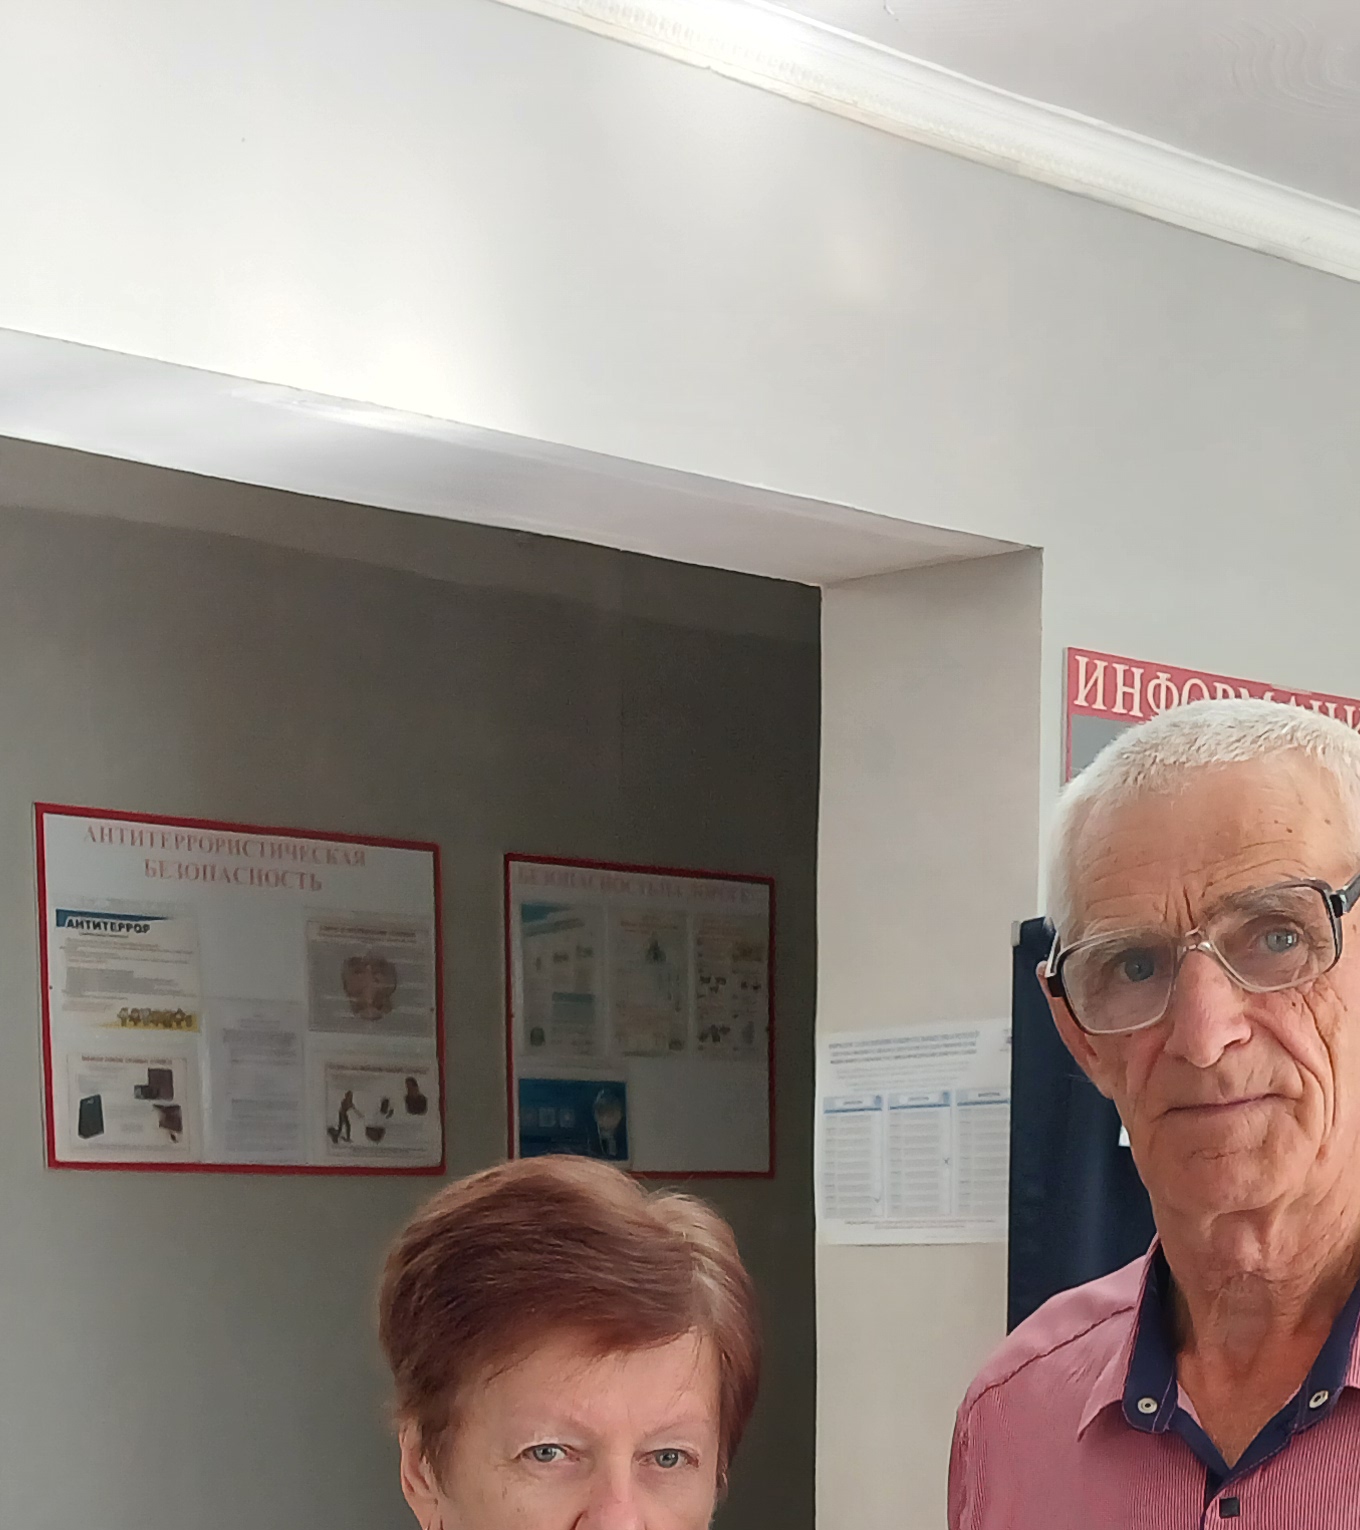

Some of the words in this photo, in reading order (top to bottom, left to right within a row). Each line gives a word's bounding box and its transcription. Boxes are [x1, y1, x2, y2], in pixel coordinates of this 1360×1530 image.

[85, 825, 366, 867] АНТИТЕРРОРИСТИЧЕСКАЯ
[144, 858, 323, 892] БЕЗОПАСНОСТЬ
[67, 918, 151, 934] АНТИТЕРРОР
